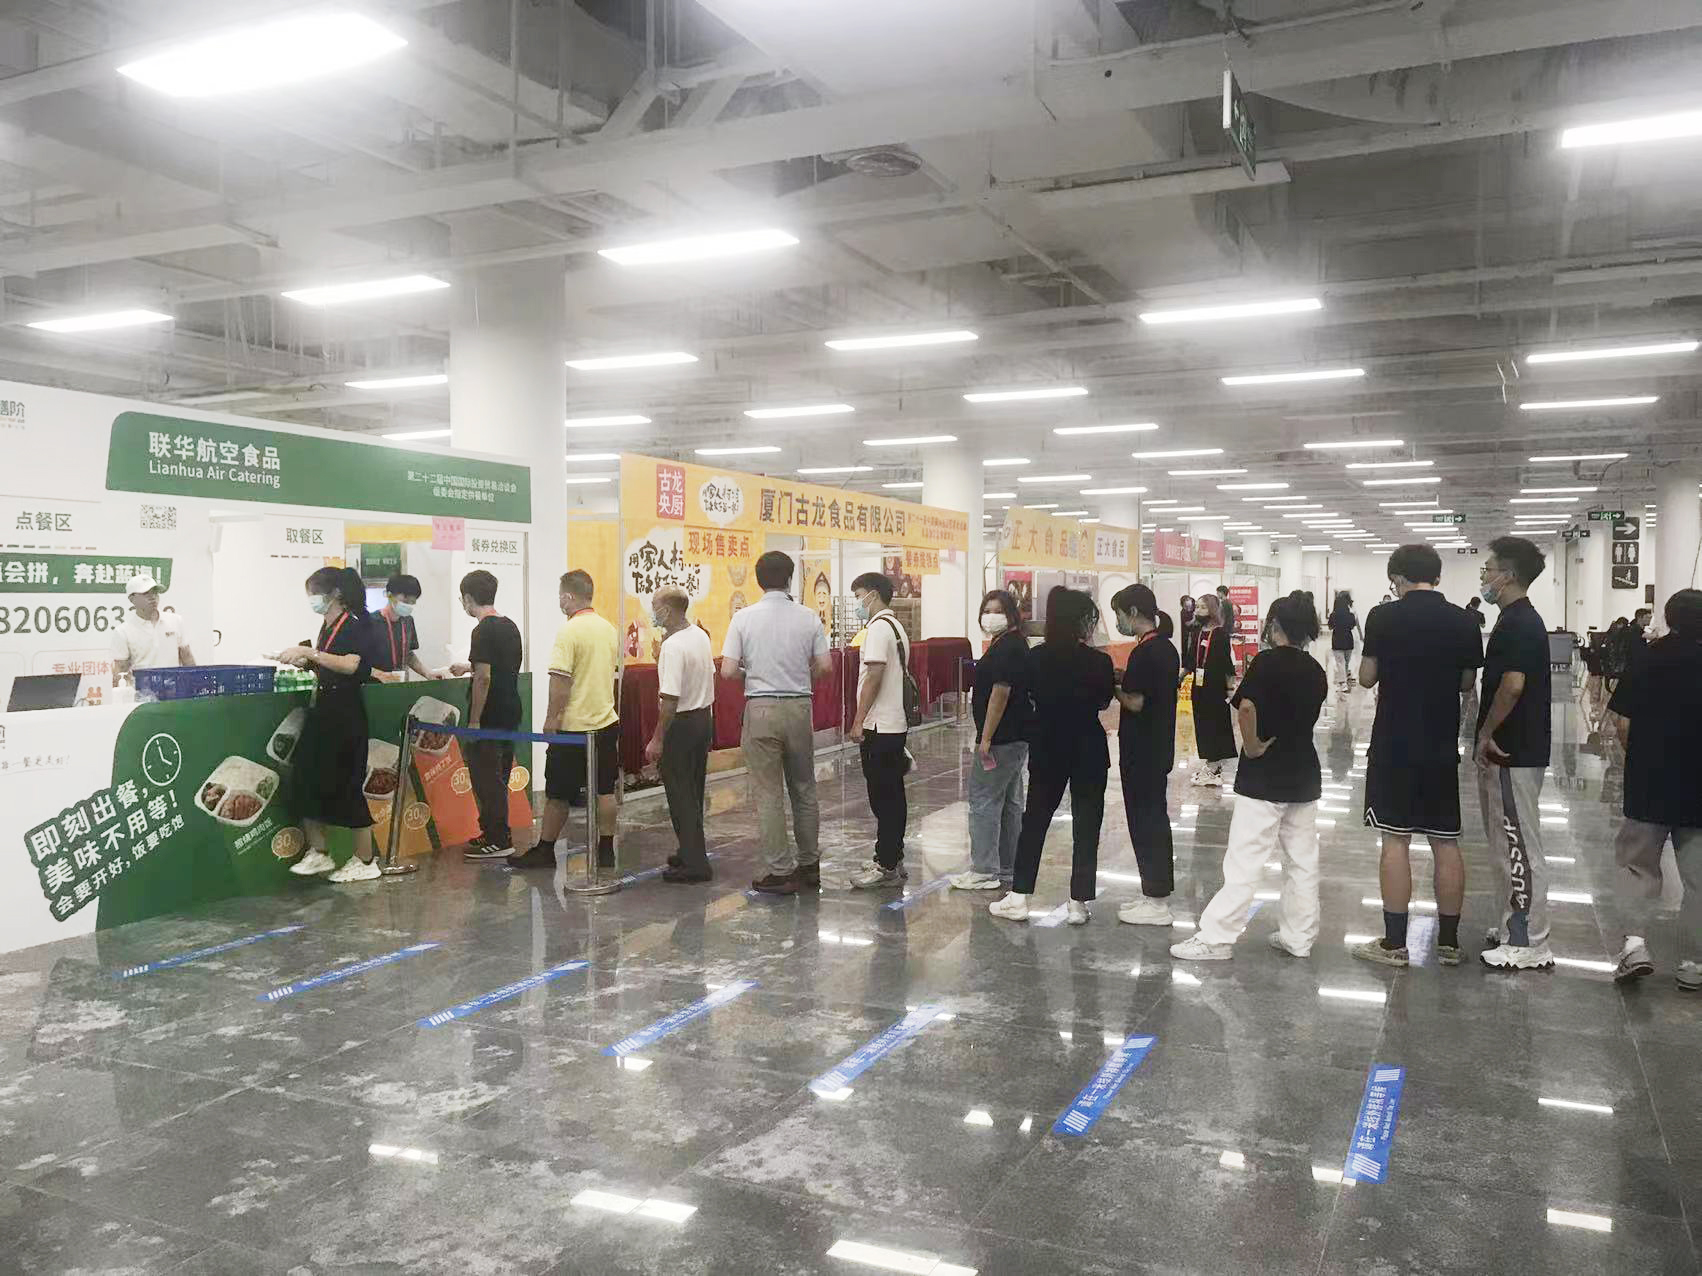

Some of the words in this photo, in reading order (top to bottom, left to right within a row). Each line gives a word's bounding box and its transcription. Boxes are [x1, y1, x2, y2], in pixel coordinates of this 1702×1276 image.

[149, 431, 281, 471] 联华航空食品
[149, 460, 204, 478] Lianhua
[207, 466, 226, 480] Air
[228, 468, 281, 489] Catering
[658, 468, 683, 493] 古龙
[657, 493, 684, 516] 央厨
[759, 487, 906, 537] 厦门古龙食品有限公司
[15, 511, 73, 532] 点餐区
[285, 527, 325, 545] 取餐区
[471, 538, 518, 554] 餐券兑换区
[688, 531, 751, 558] 现场售卖点
[1011, 519, 1069, 558] 正大食品
[1096, 537, 1125, 558] 正大食品
[30, 779, 149, 862] 即刻出餐，
[44, 789, 178, 895] 美味不用等！
[55, 813, 185, 916] 会要开好，饭要吃饱
